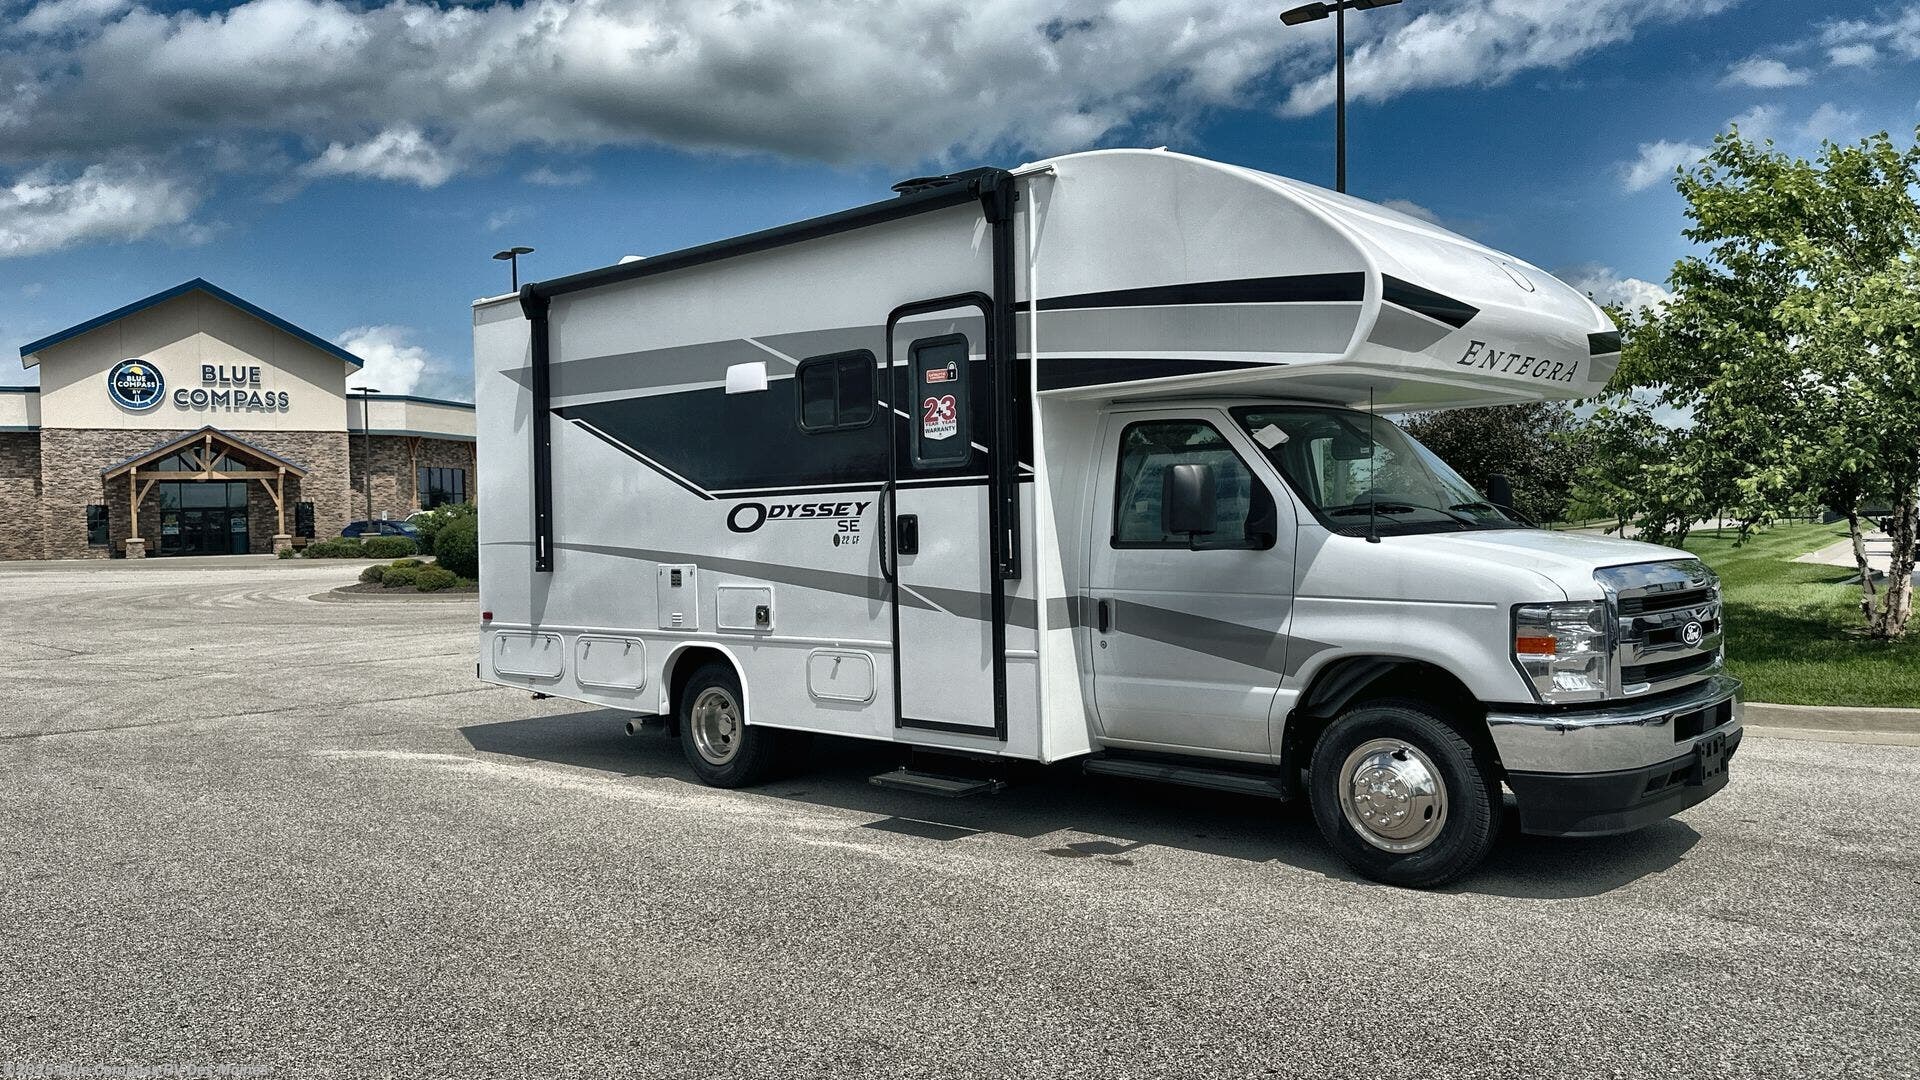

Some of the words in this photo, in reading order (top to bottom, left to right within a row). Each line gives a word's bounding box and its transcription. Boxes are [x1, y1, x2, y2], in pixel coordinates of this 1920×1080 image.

[1457, 340, 1578, 382] ENTEGRA
[202, 364, 261, 383] BLUE
[173, 388, 289, 407] COMPASS
[925, 426, 956, 434] WARRANTY
[727, 501, 872, 533] ODYSSEY
[838, 520, 860, 533] SE
[841, 535, 850, 545] 22
[1686, 624, 1700, 641] Ford
